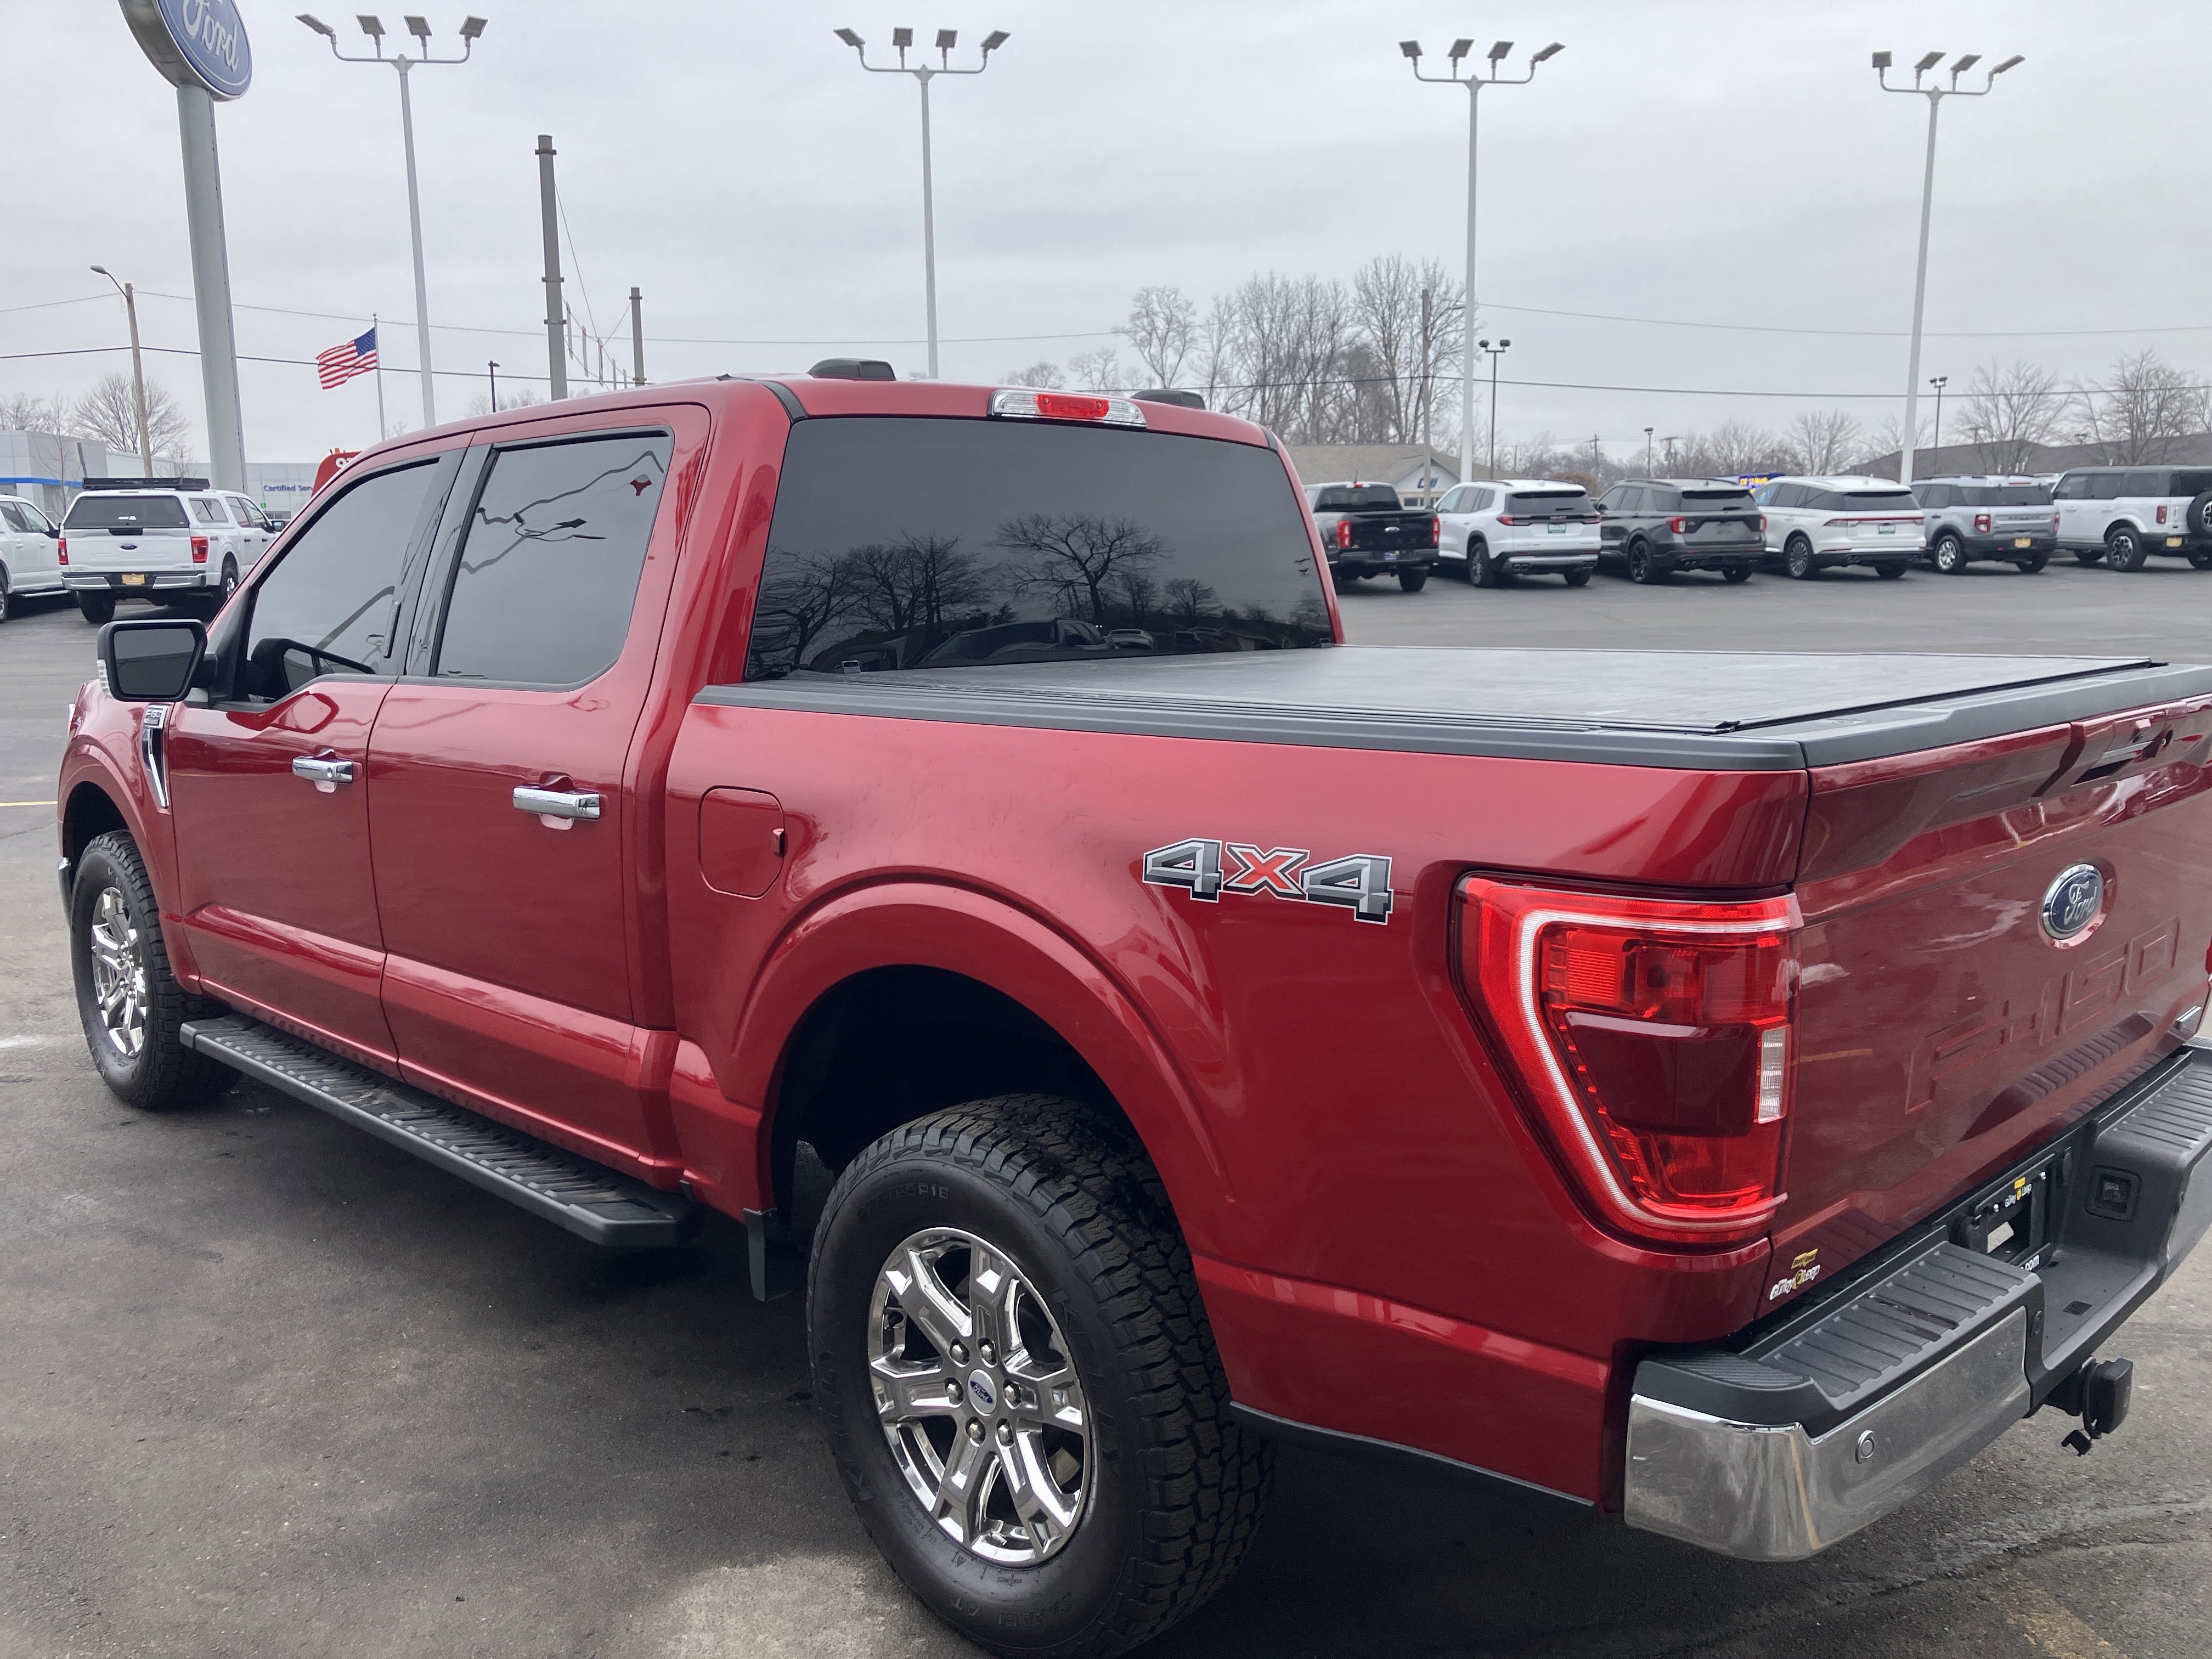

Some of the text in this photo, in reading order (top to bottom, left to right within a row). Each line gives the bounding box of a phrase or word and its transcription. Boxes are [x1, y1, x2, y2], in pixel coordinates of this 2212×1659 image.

[183, 0, 238, 72] Ford
[2063, 880, 2098, 926] Ford
[973, 1384, 990, 1402] Ford
